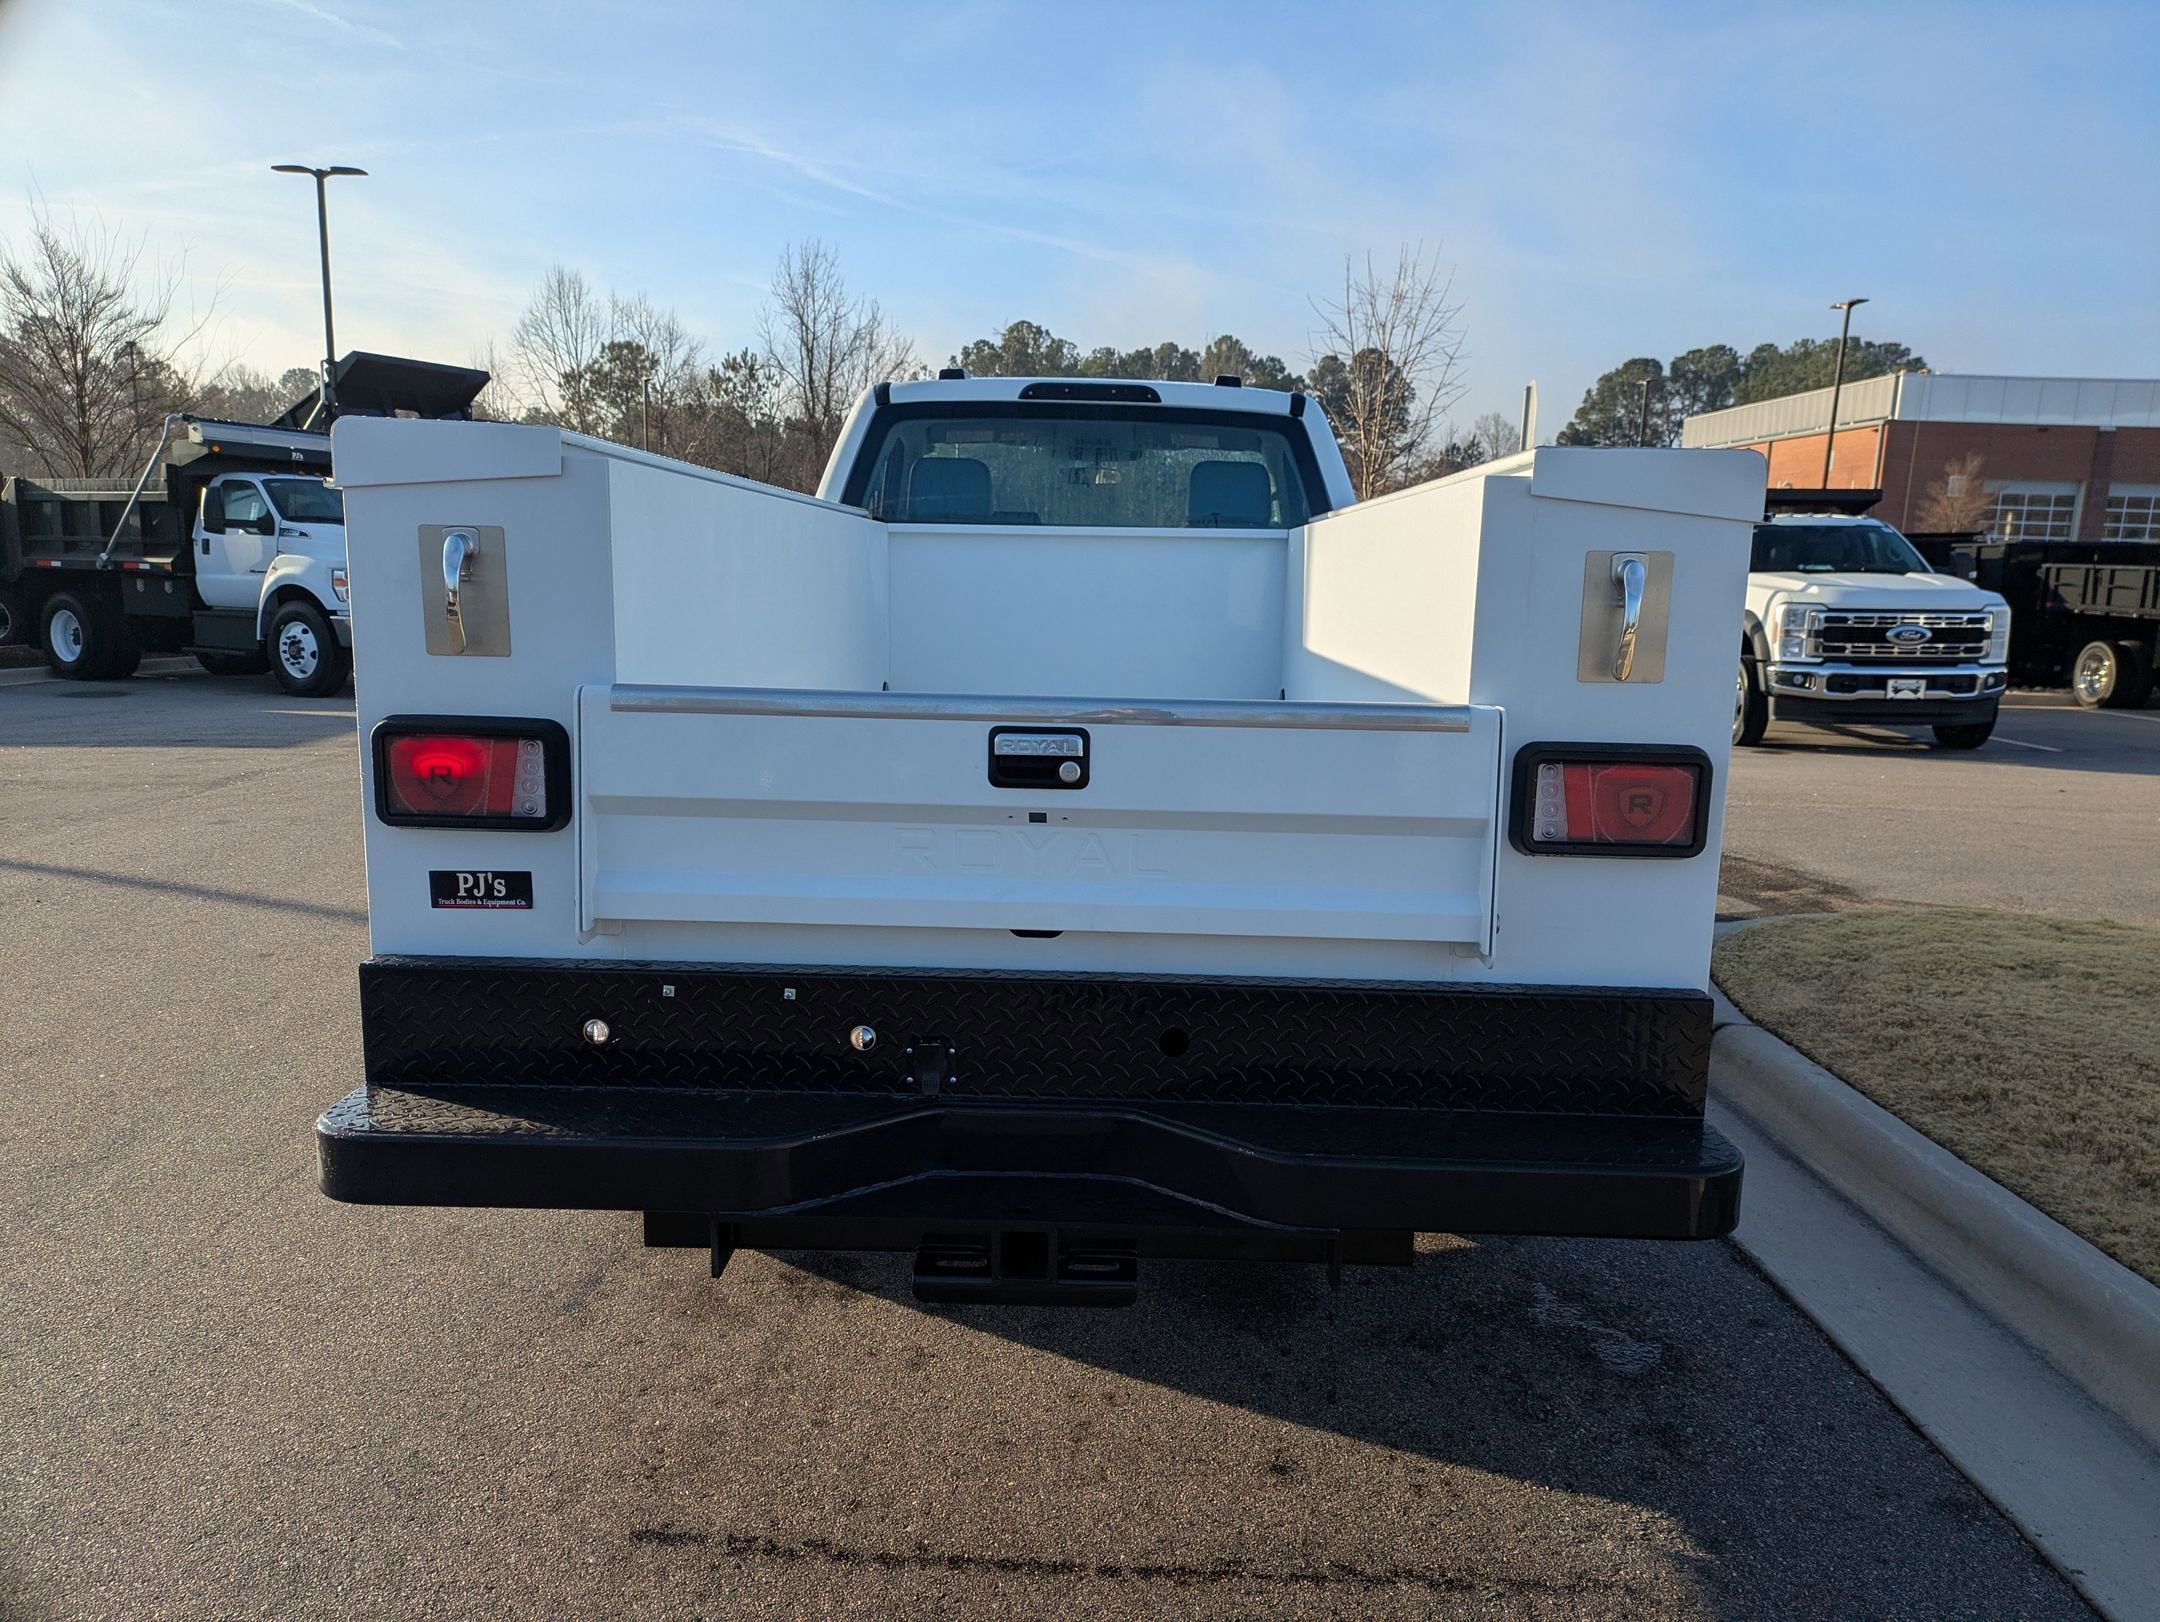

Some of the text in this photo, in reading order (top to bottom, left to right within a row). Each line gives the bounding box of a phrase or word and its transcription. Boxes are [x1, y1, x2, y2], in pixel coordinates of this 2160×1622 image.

[1000, 739, 1078, 753] ROYAL
[429, 765, 452, 785] R
[1628, 794, 1653, 814] R
[893, 827, 1169, 878] ROYAL
[456, 871, 507, 897] PJ's
[483, 898, 516, 908] Equipment
